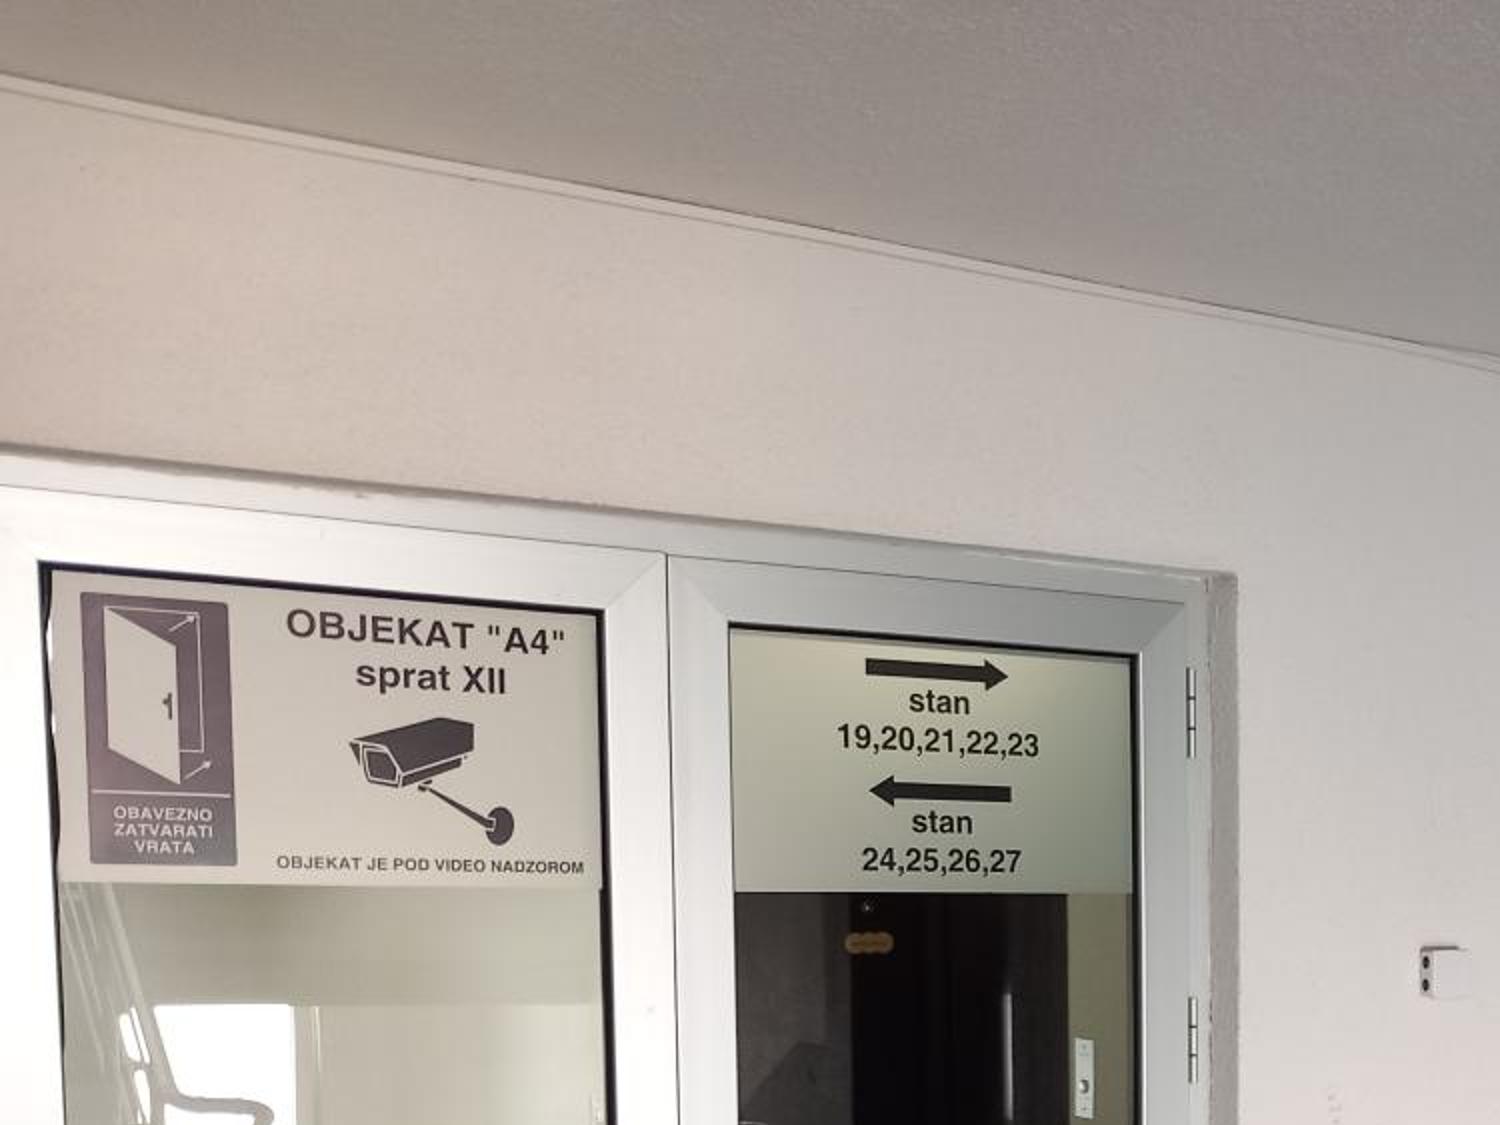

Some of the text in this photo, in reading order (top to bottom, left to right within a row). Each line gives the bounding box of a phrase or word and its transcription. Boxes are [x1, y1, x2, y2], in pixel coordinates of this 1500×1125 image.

[286, 608, 565, 655] OBJEKAT "A4"
[356, 662, 506, 696] sprat XII
[909, 690, 970, 715] stan
[837, 724, 1039, 759] 19,20,21,22,23
[112, 806, 213, 822] OBAVEZNO
[911, 810, 973, 834] stan
[113, 823, 214, 839] ZATVARATI
[134, 840, 195, 855] VRATA
[276, 855, 585, 875] OBJEKAT JE POD VIDEO NADZOROM
[862, 847, 1022, 877] 24,25,26,27
